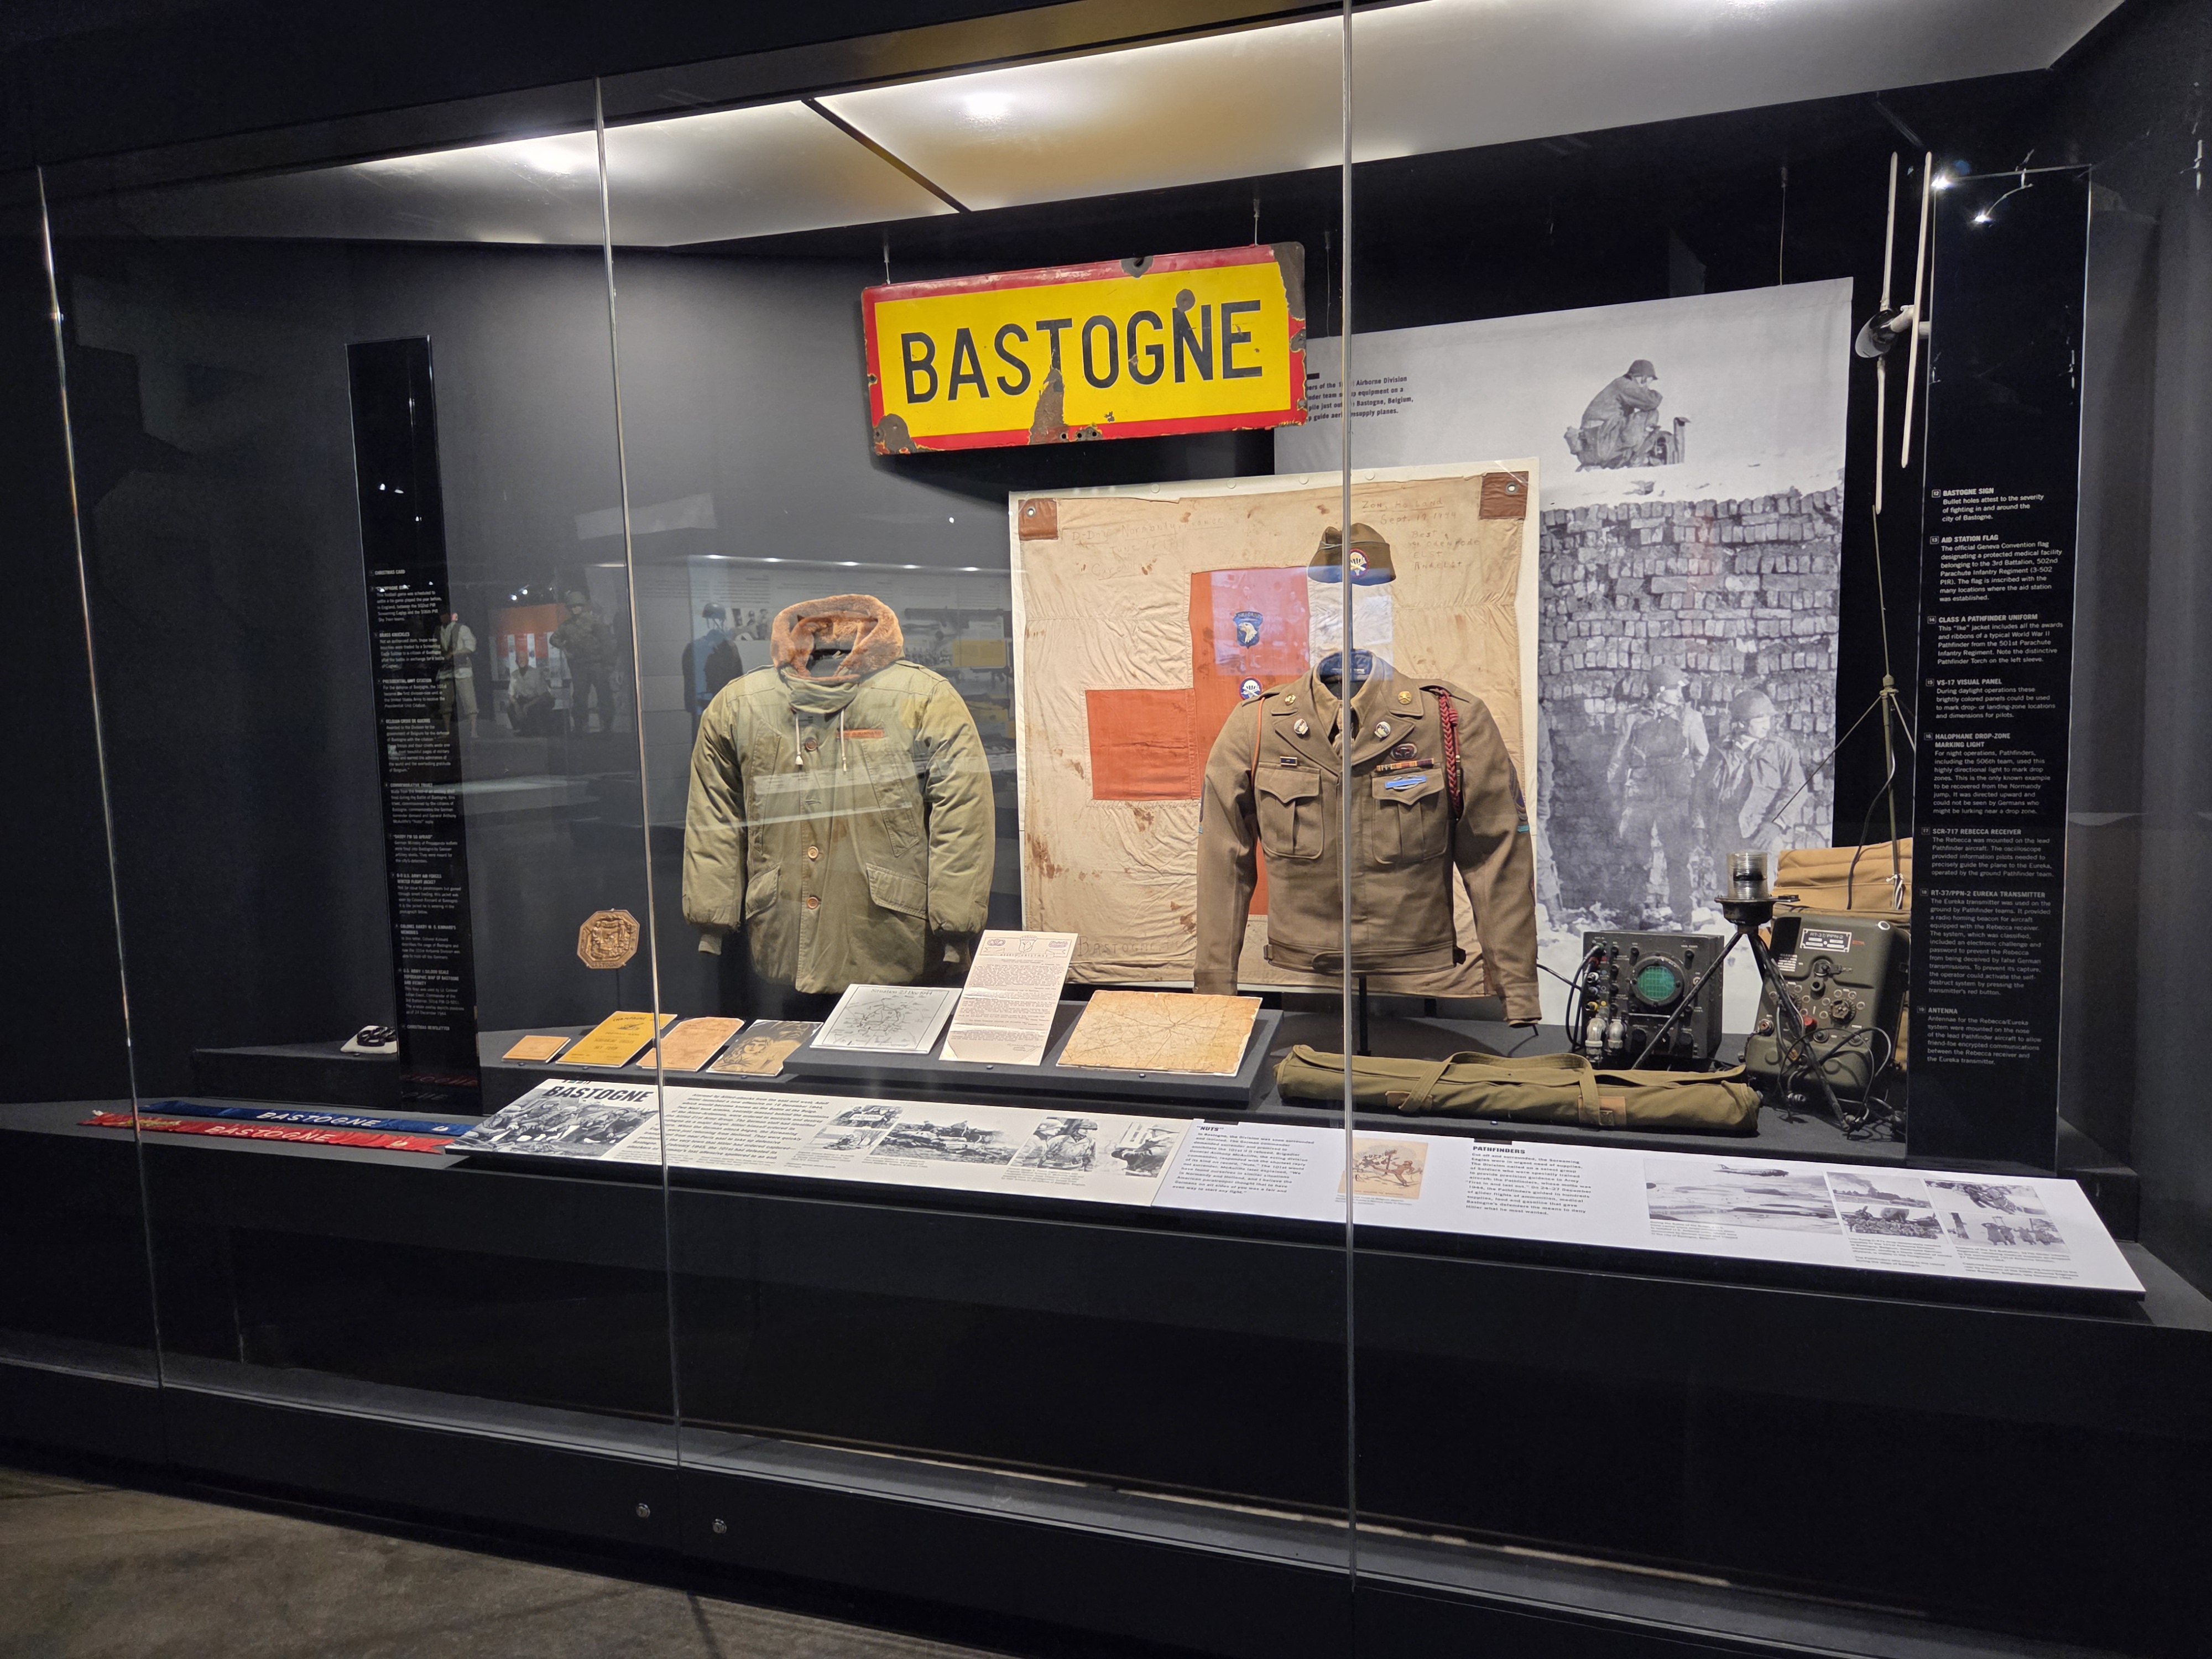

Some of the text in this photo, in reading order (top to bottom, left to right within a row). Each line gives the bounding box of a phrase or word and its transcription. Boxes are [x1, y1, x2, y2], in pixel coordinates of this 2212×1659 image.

[901, 299, 1263, 404] BASTOGNE
[1358, 388, 1389, 397] equipment
[1308, 403, 1319, 412] pile
[1313, 413, 1329, 421] guide
[542, 1086, 654, 1103] BASTOGNE
[257, 1112, 381, 1128] BASTOGNE
[205, 1125, 336, 1142] BASTOGNE
